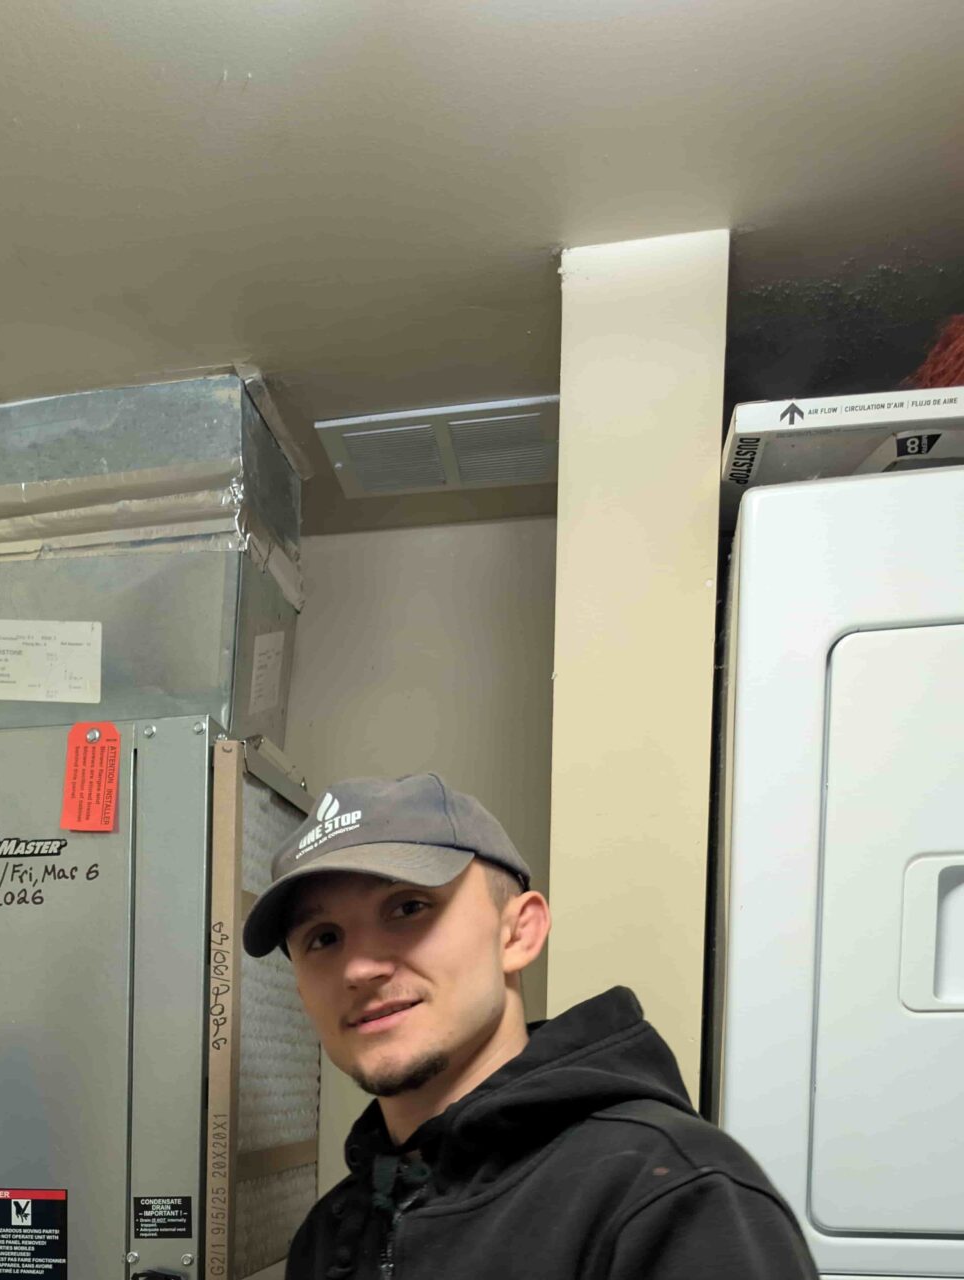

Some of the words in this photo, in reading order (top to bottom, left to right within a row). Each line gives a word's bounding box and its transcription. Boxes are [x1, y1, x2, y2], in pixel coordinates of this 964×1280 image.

[845, 403, 885, 412] CIRCULATION
[728, 437, 761, 485] DUSTSTOP
[906, 438, 919, 453] 8
[107, 746, 116, 784] ATTENTION
[103, 789, 112, 825] INSTALLER
[299, 824, 322, 849] ONE
[325, 810, 361, 834] STOP
[86, 863, 100, 880] 6
[212, 1114, 226, 1178] 20X20X1
[211, 1187, 226, 1235] 9/5/25
